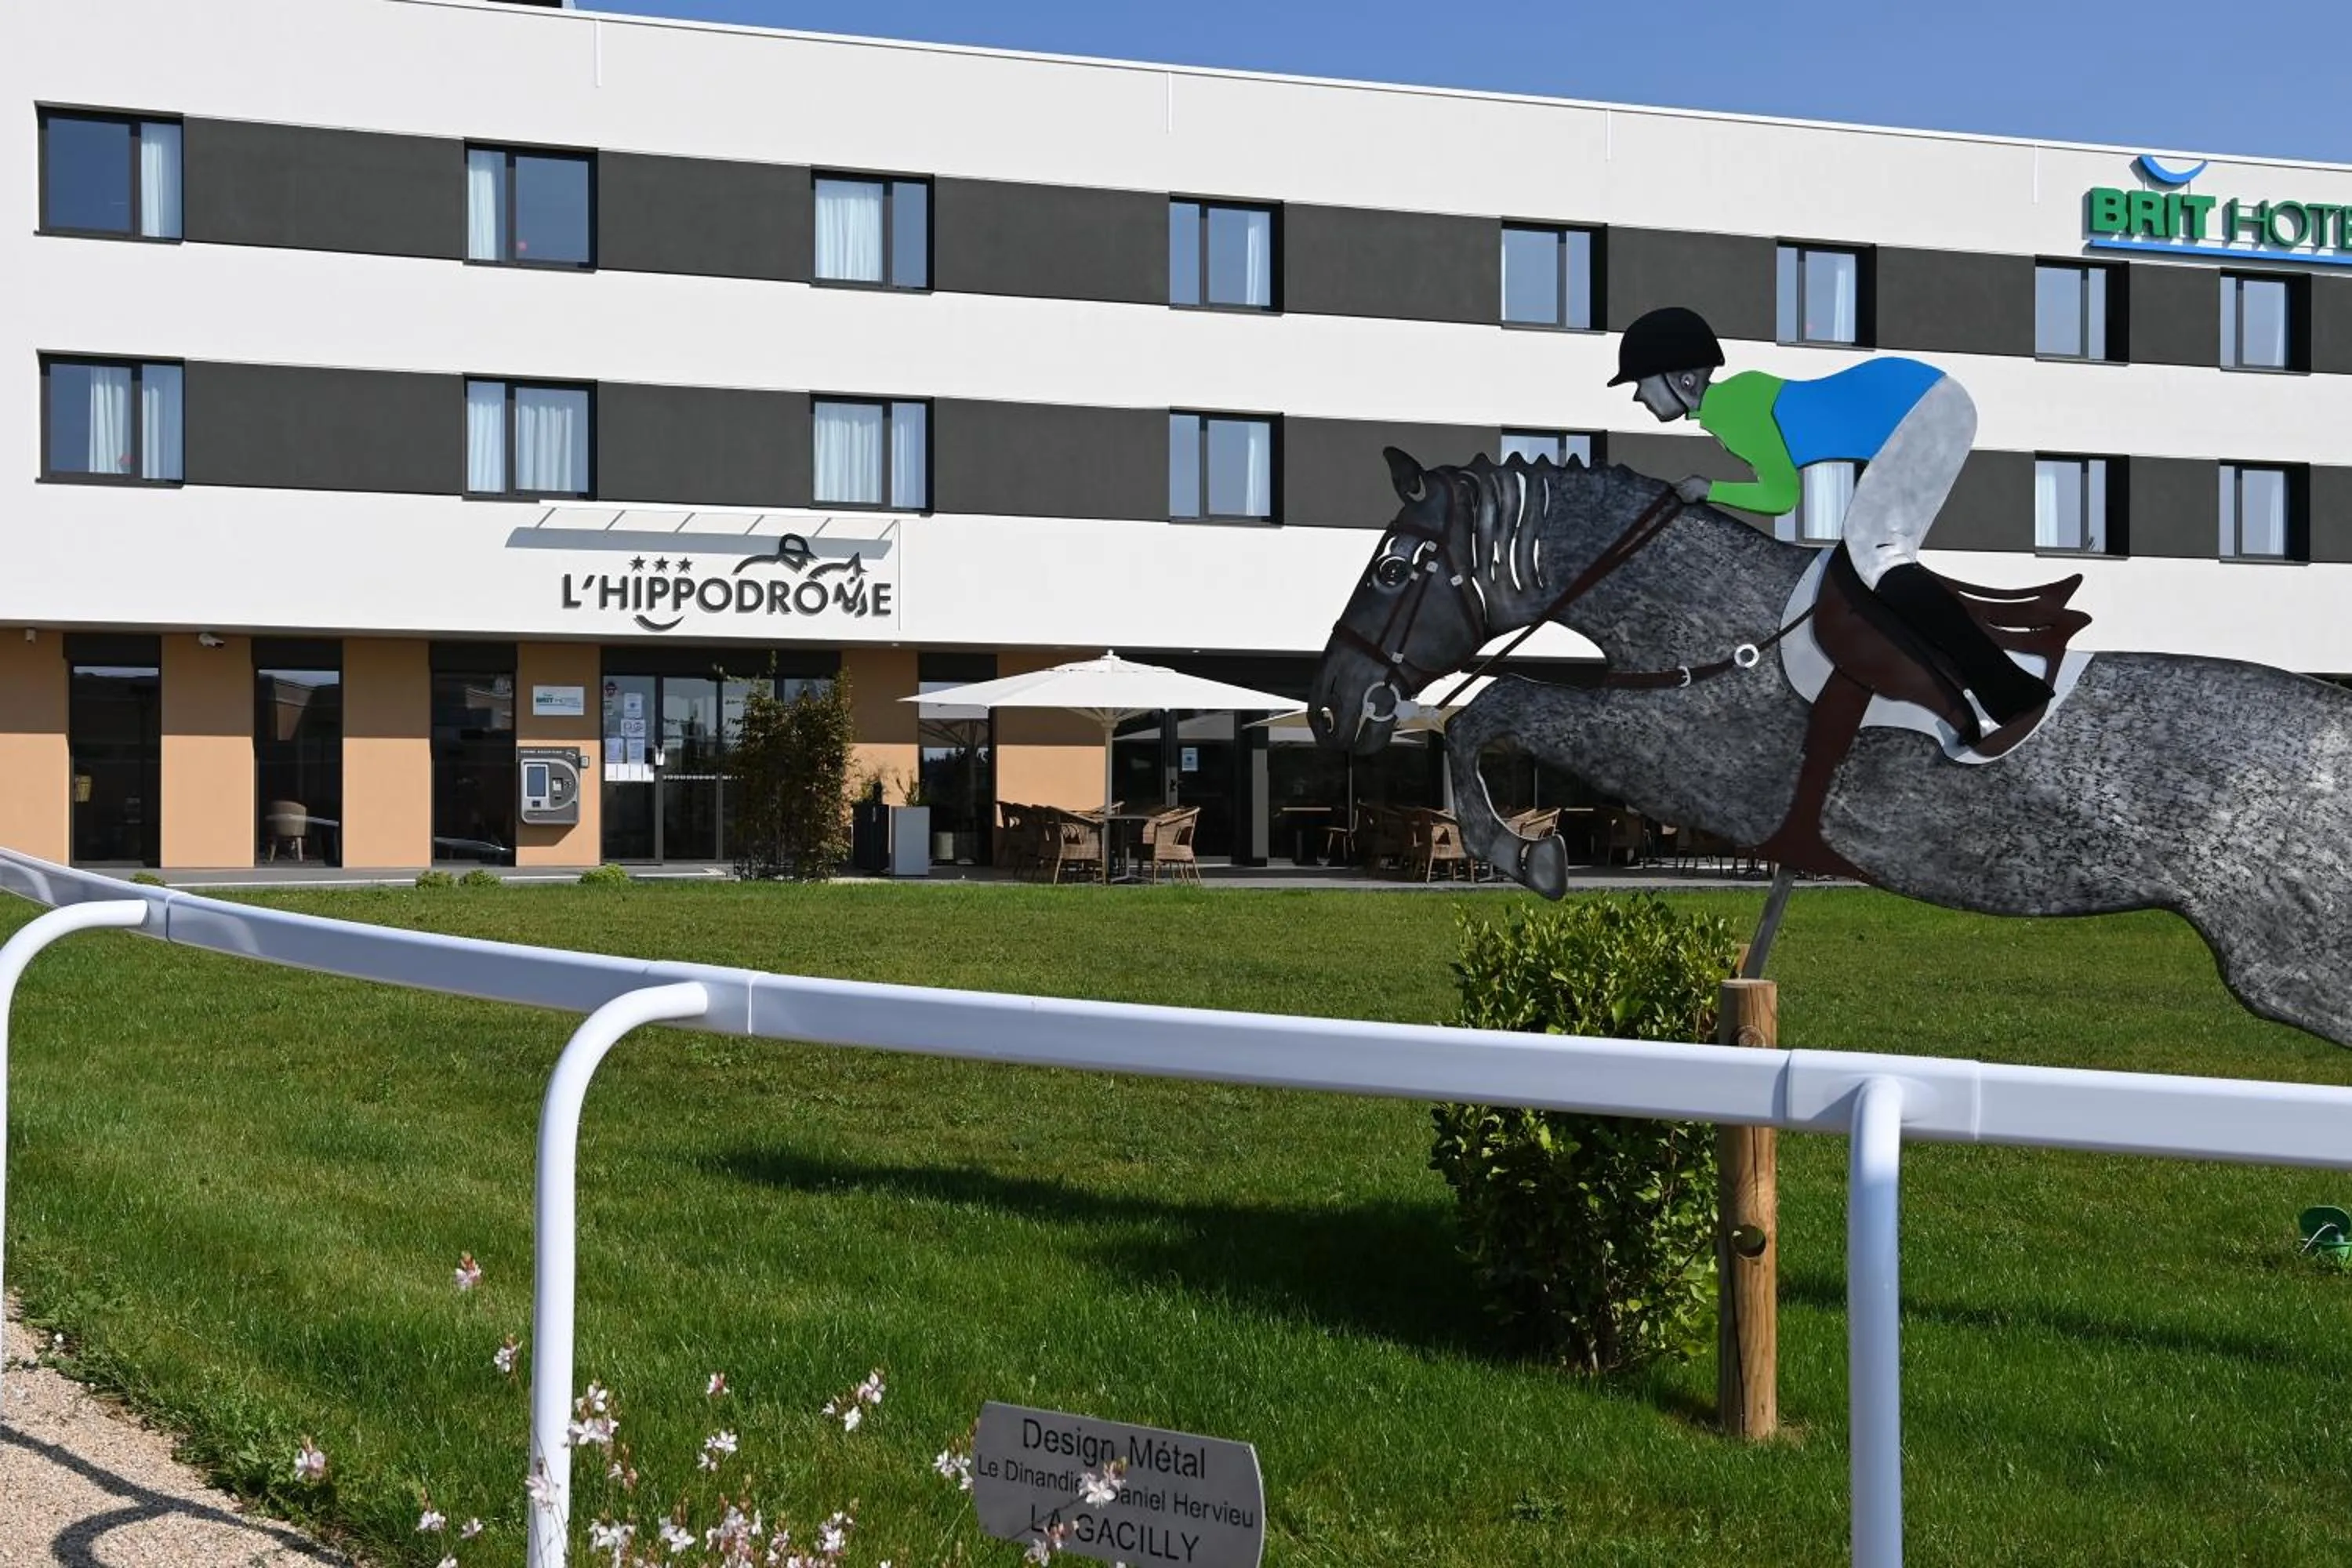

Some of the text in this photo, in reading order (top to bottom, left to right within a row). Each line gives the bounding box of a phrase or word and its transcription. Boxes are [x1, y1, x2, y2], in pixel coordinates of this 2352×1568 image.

[2089, 187, 2216, 240] BRIT
[1022, 1417, 1205, 1480] Design Métal
[977, 1453, 999, 1478] Le
[1005, 1459, 1100, 1495] Dinandi
[1174, 1492, 1254, 1529] Hervieu
[1075, 1512, 1200, 1563] GACILLY
